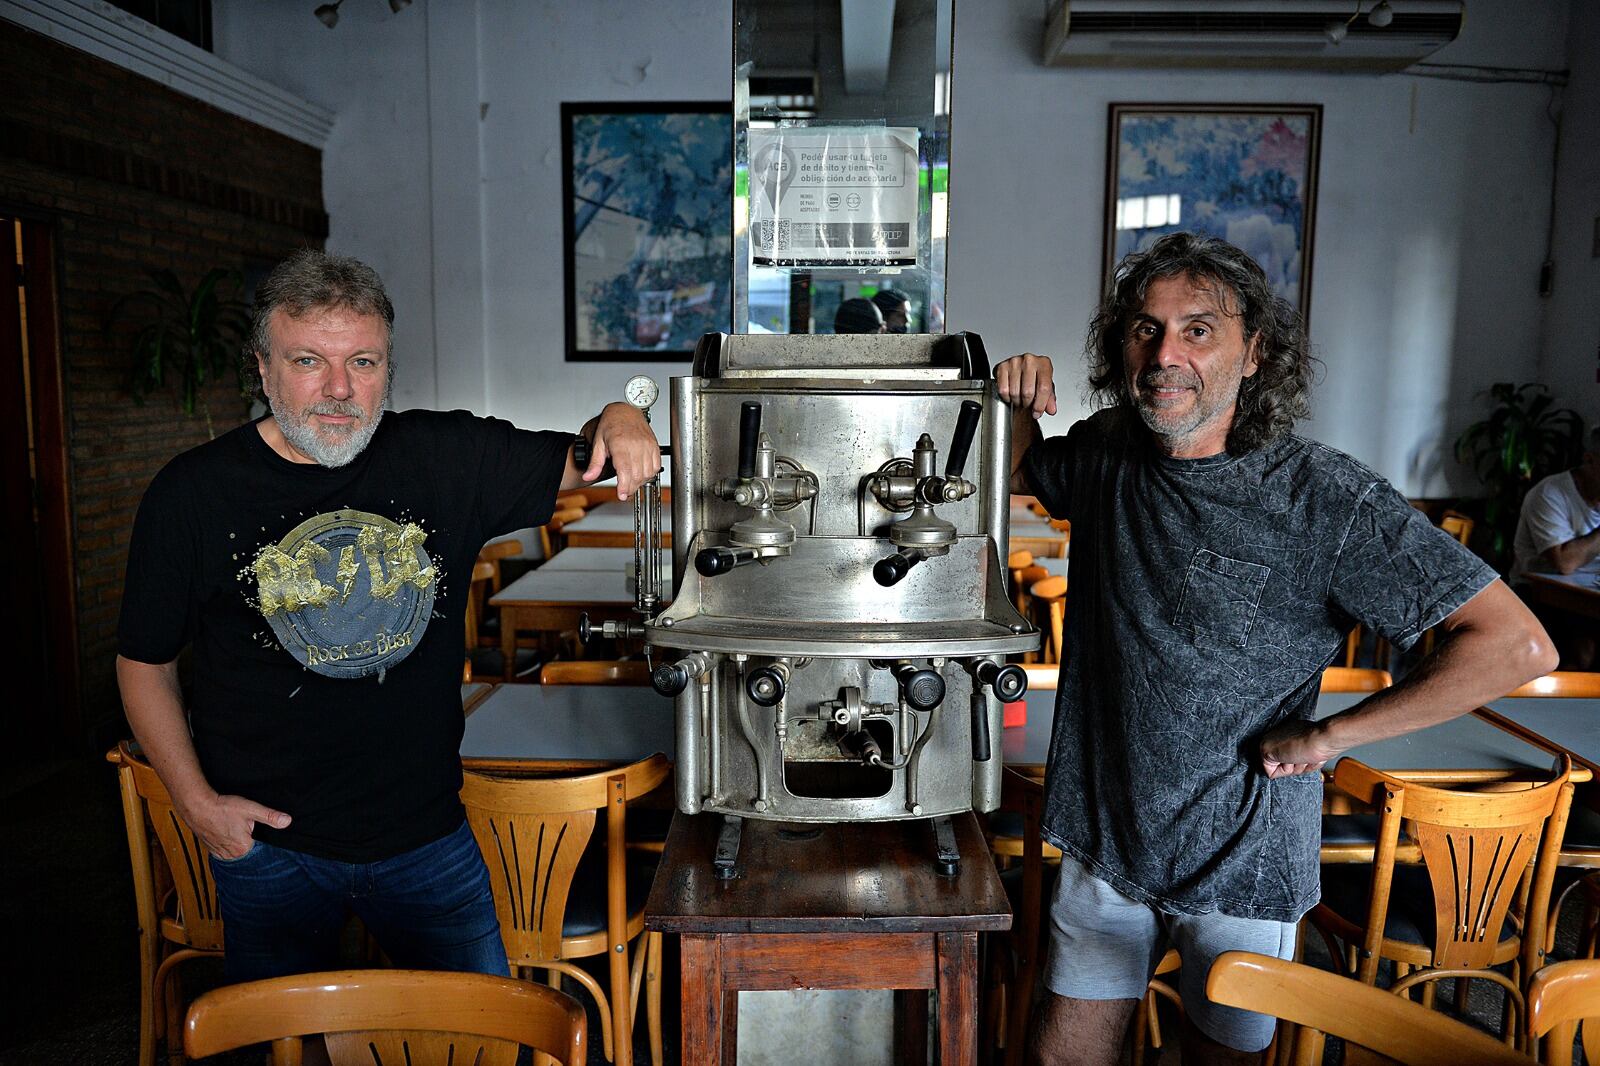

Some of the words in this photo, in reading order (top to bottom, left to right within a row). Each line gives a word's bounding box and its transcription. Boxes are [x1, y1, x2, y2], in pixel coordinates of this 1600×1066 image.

[860, 153, 888, 162] tjeta
[764, 159, 788, 171] Acá
[841, 165, 846, 173] y
[876, 163, 884, 171] la
[800, 174, 844, 184] obligción
[845, 174, 856, 182] de
